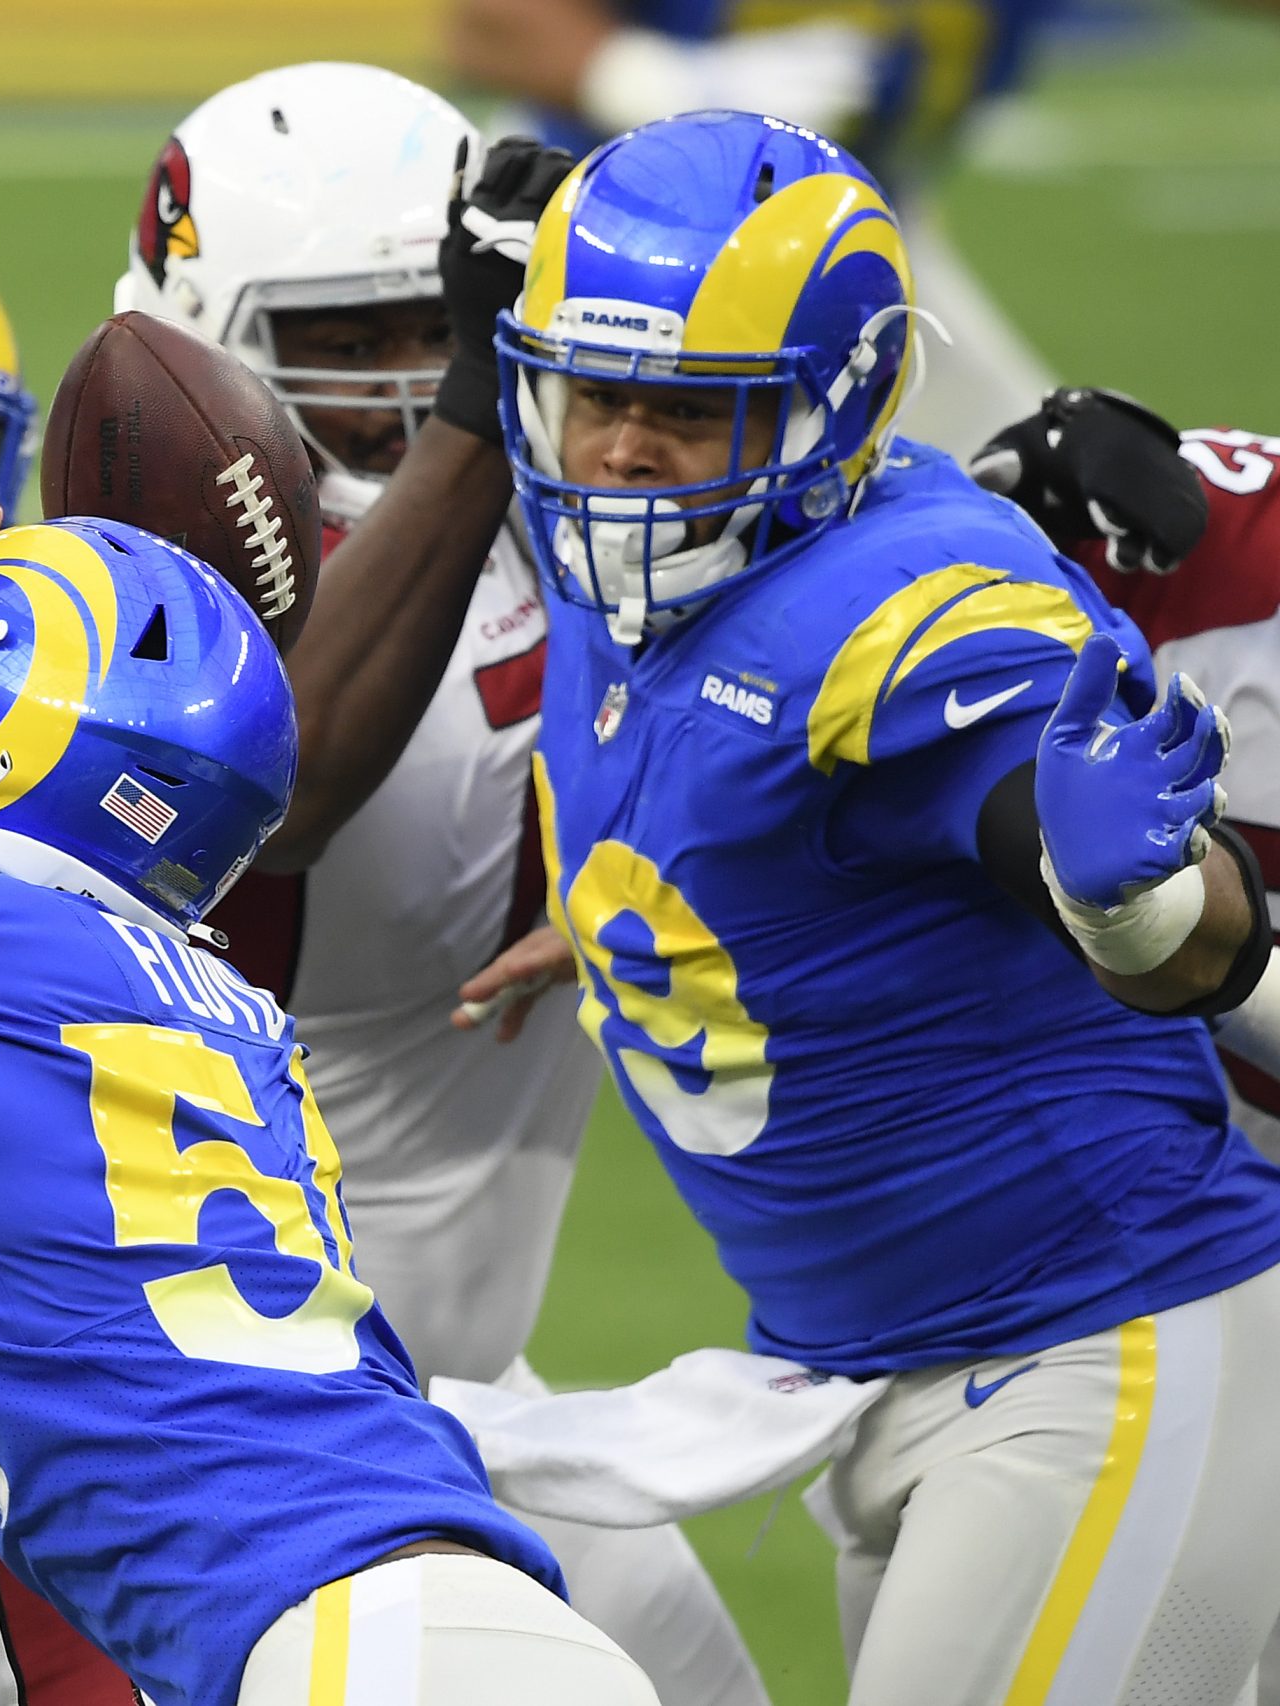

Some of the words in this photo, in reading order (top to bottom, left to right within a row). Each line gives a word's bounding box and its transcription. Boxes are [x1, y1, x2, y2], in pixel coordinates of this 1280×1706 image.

[581, 311, 649, 332] RAMS
[700, 673, 774, 726] RAMS
[98, 910, 287, 1041] FLOYD
